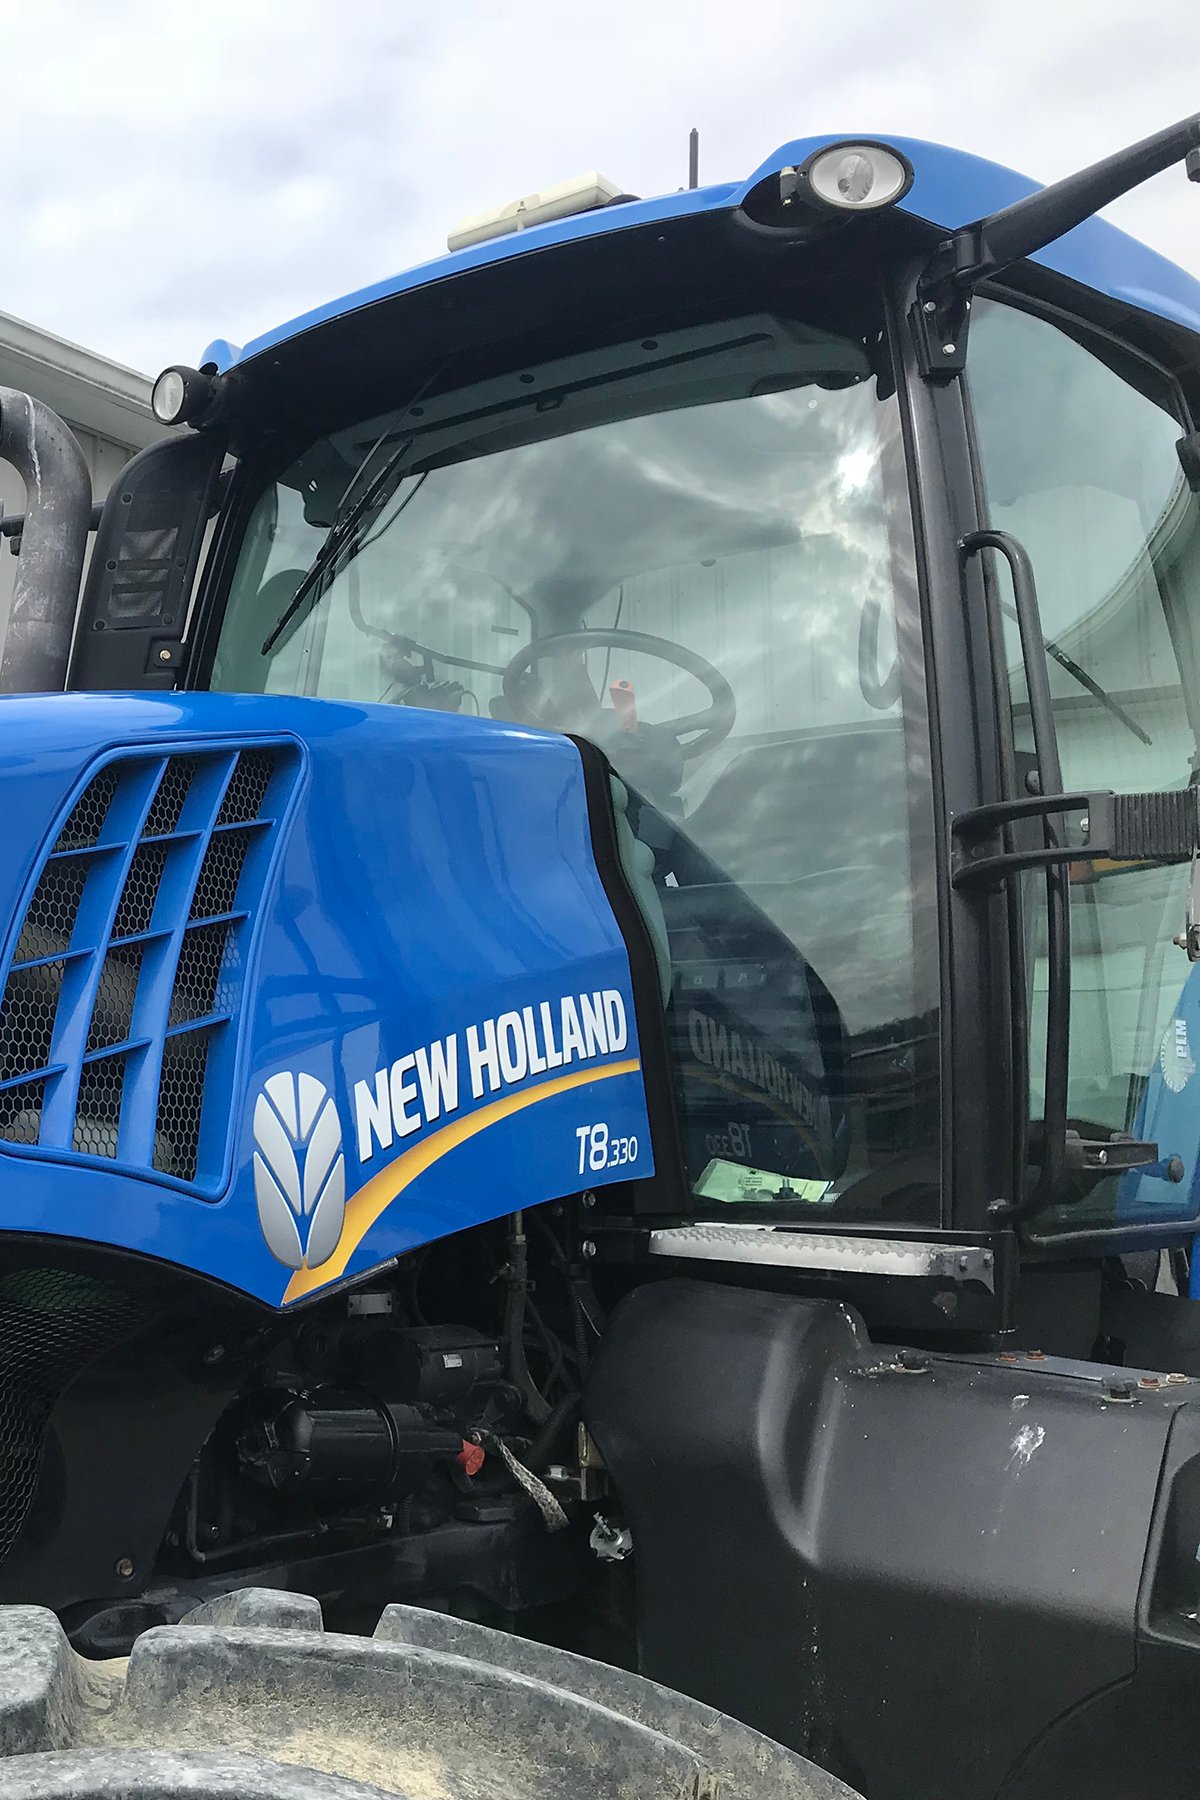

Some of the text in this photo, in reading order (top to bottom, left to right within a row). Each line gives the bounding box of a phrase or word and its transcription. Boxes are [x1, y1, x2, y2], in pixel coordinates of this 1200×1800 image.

[1175, 1019, 1187, 1058] PLM
[353, 989, 628, 1164] NEW HOLLAND
[576, 1122, 638, 1175] T8.330
